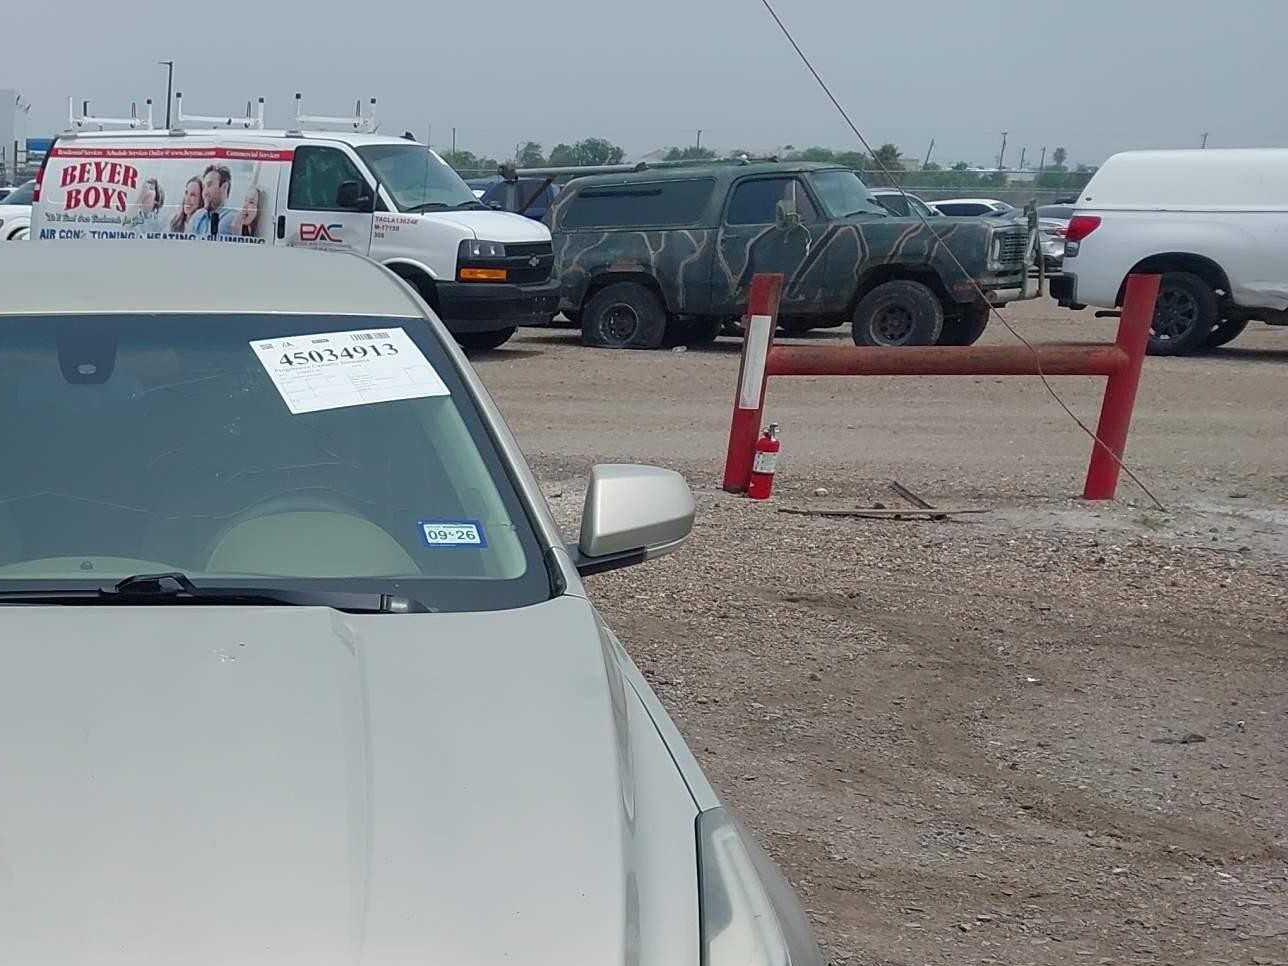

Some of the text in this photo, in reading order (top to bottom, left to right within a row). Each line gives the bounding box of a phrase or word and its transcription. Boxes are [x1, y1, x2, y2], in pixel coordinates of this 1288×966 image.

[60, 161, 138, 189] BEYER
[64, 186, 127, 213] BOYS
[39, 228, 56, 240] AIR
[279, 343, 399, 366] 45034913
